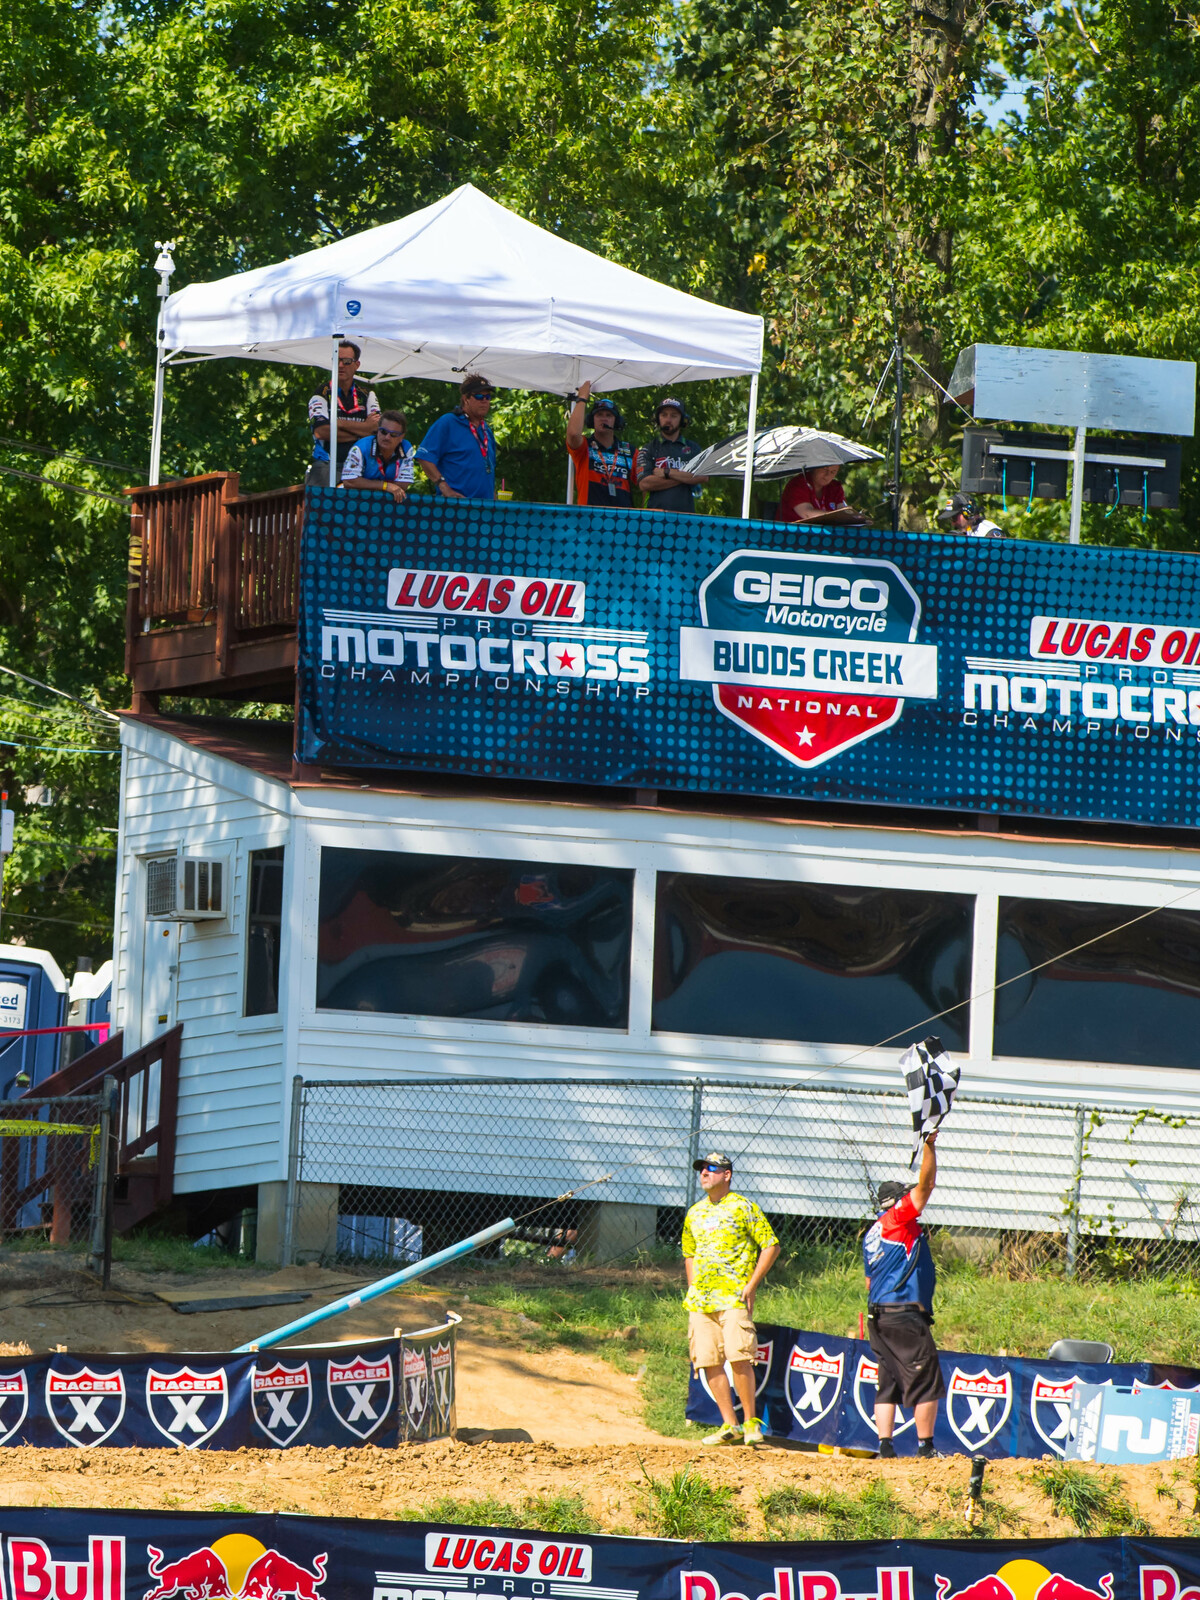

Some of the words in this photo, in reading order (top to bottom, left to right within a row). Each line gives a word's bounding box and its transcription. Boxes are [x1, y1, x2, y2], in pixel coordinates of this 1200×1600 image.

[395, 573, 514, 614] LUCAS
[520, 581, 579, 617] OIL
[733, 570, 890, 611] GEICO
[443, 618, 527, 635] PRO
[764, 605, 887, 635] Motorcycle
[321, 625, 650, 683] MOTOCROSS
[1038, 621, 1156, 662] LUCAS
[1161, 630, 1200, 666] OI
[713, 640, 806, 678] BUDDS
[813, 648, 904, 686] CREEK
[1085, 666, 1168, 684] PRO
[321, 665, 650, 699] CHAMPIONSHIP
[964, 673, 1200, 726] MOTOCR
[737, 695, 878, 718] NATIONAL
[963, 712, 1200, 742] CHAMPION
[255, 1373, 306, 1388] RACER
[332, 1366, 388, 1381] RACER
[793, 1356, 839, 1374] RACER
[53, 1380, 118, 1392] RACER
[152, 1380, 221, 1391] RACER
[345, 1384, 379, 1422] X
[409, 1376, 423, 1414] X
[437, 1369, 449, 1406] X
[795, 1373, 828, 1413] X
[954, 1380, 1003, 1393] RACER
[1038, 1387, 1074, 1399] RAC
[68, 1396, 105, 1433] X
[167, 1395, 208, 1433] X
[265, 1391, 298, 1429] X
[960, 1396, 996, 1434] X
[1170, 1397, 1187, 1460] MOTOCR
[1101, 1414, 1168, 1455] 2
[8, 1535, 126, 1600] Bull
[433, 1537, 533, 1574] LUCAS
[539, 1544, 585, 1577] OIL
[473, 1578, 545, 1595] PRO
